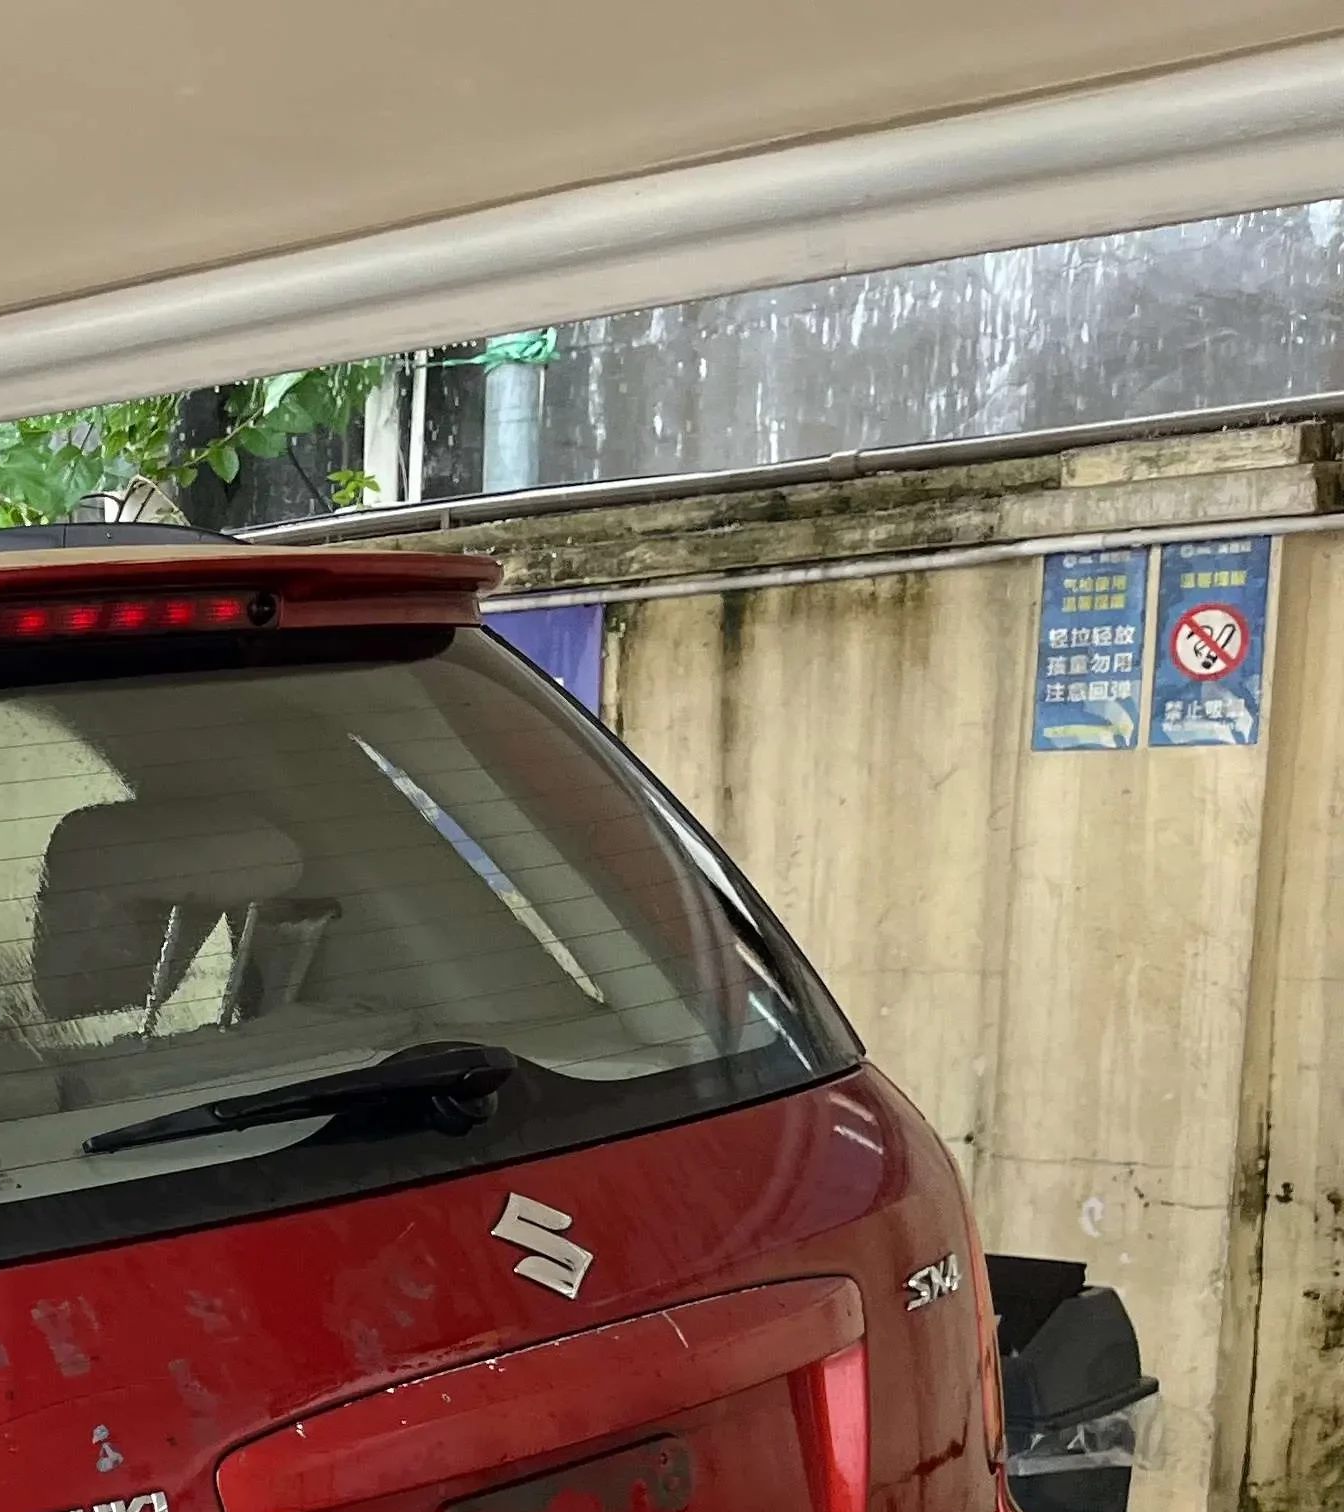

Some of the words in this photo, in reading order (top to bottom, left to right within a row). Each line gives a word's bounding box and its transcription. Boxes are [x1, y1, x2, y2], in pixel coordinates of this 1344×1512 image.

[1049, 624, 1136, 648] 轻拉轻放
[1045, 680, 1132, 703] 注意回弹
[907, 1253, 962, 1311] SX4
